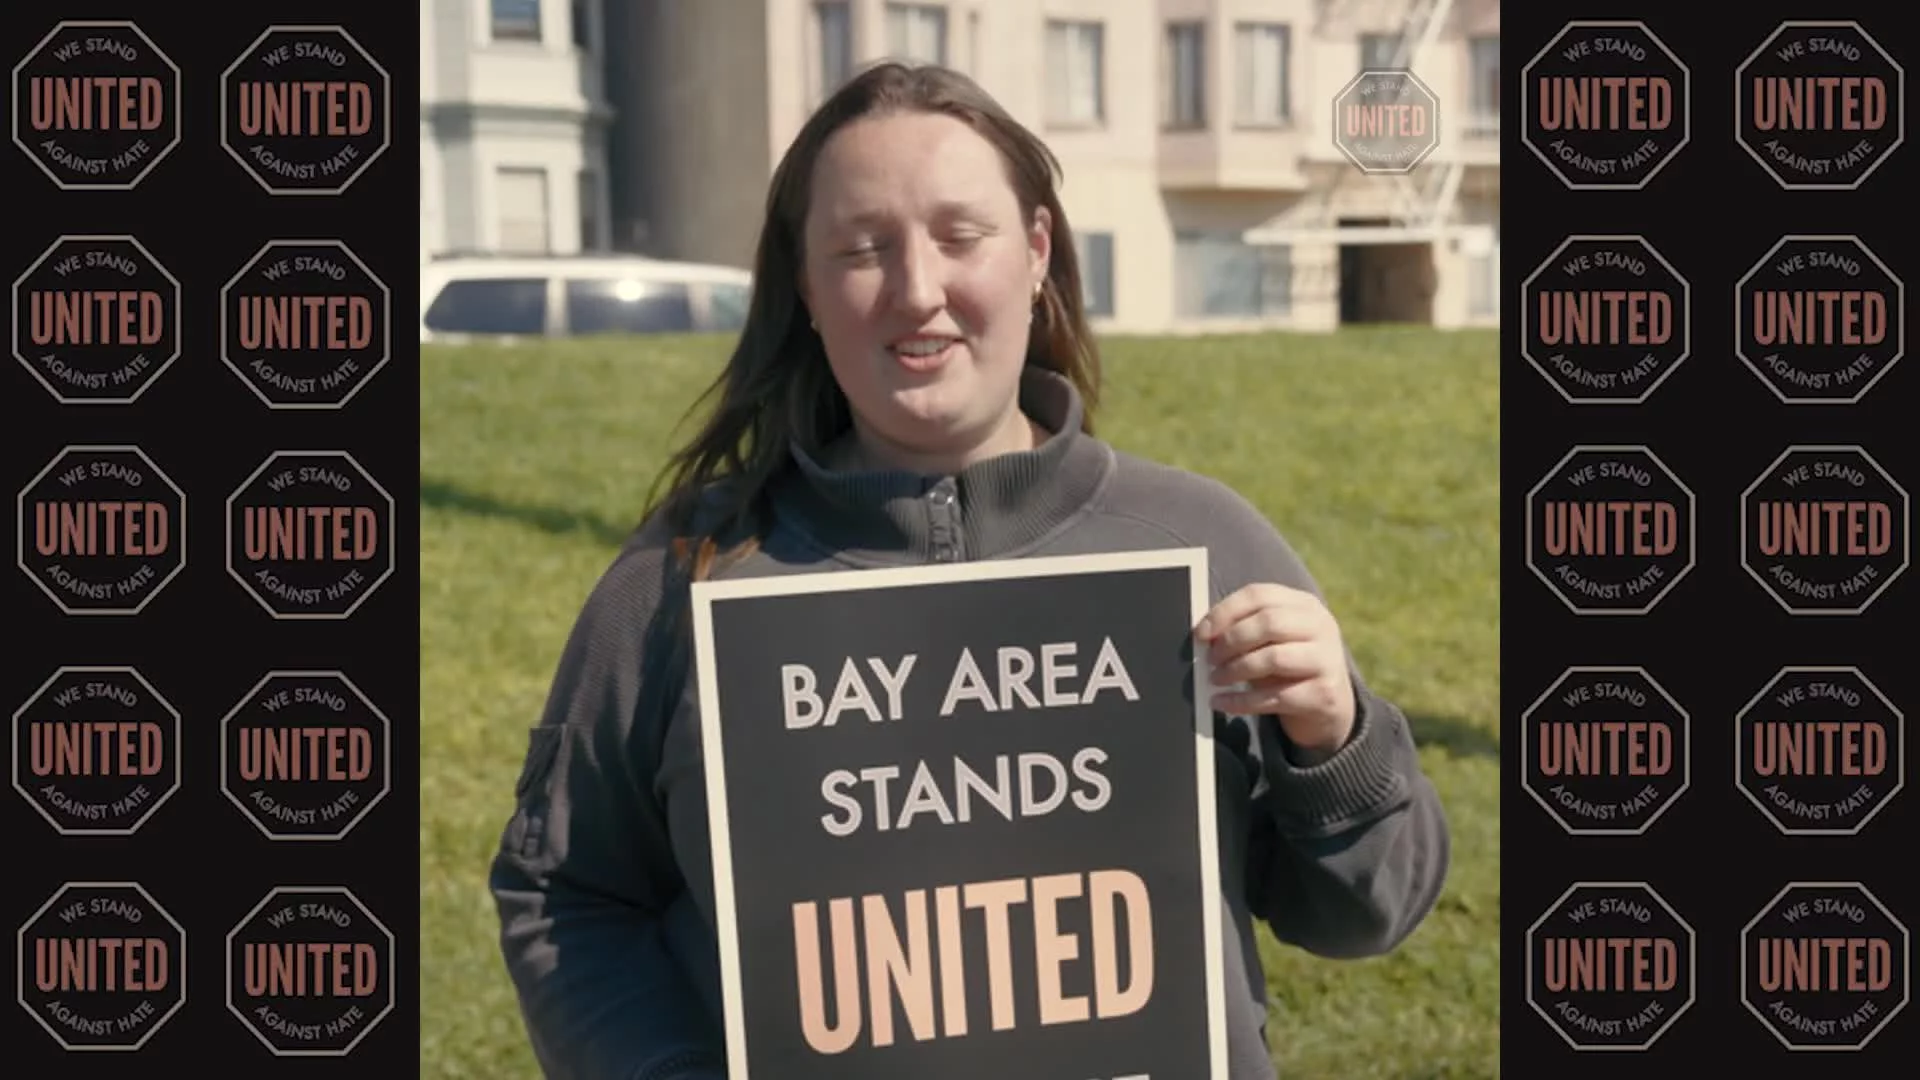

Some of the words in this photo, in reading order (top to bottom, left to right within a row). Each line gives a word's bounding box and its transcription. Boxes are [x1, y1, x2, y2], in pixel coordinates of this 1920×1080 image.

[782, 654, 917, 729] BAY
[940, 636, 1140, 716] AREA
[820, 747, 1112, 836] STANDS
[792, 869, 1155, 1054] UNITED
